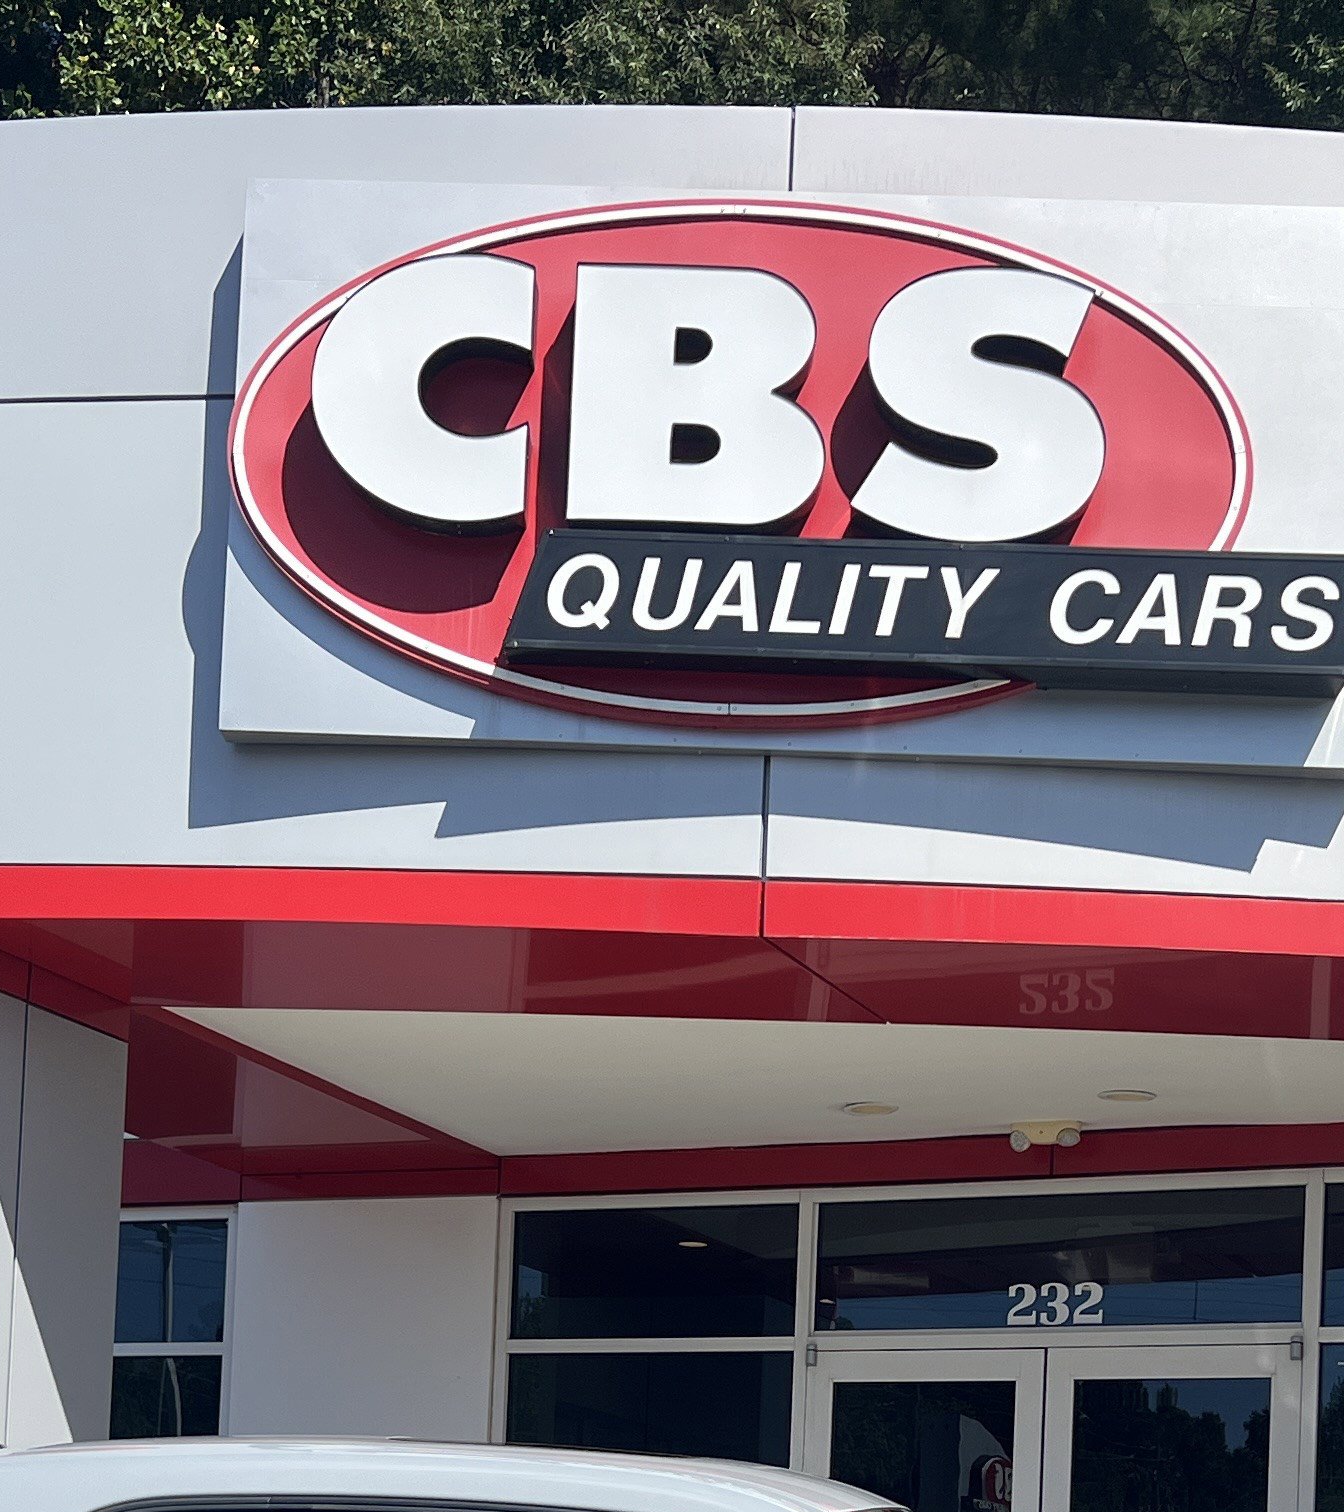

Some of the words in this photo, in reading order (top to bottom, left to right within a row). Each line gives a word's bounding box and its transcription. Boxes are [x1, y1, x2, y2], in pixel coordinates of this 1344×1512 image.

[310, 253, 1106, 543] CBS
[544, 551, 1002, 641] QUALITY
[1049, 568, 1343, 653] CARS
[1006, 1281, 1105, 1327] 232
